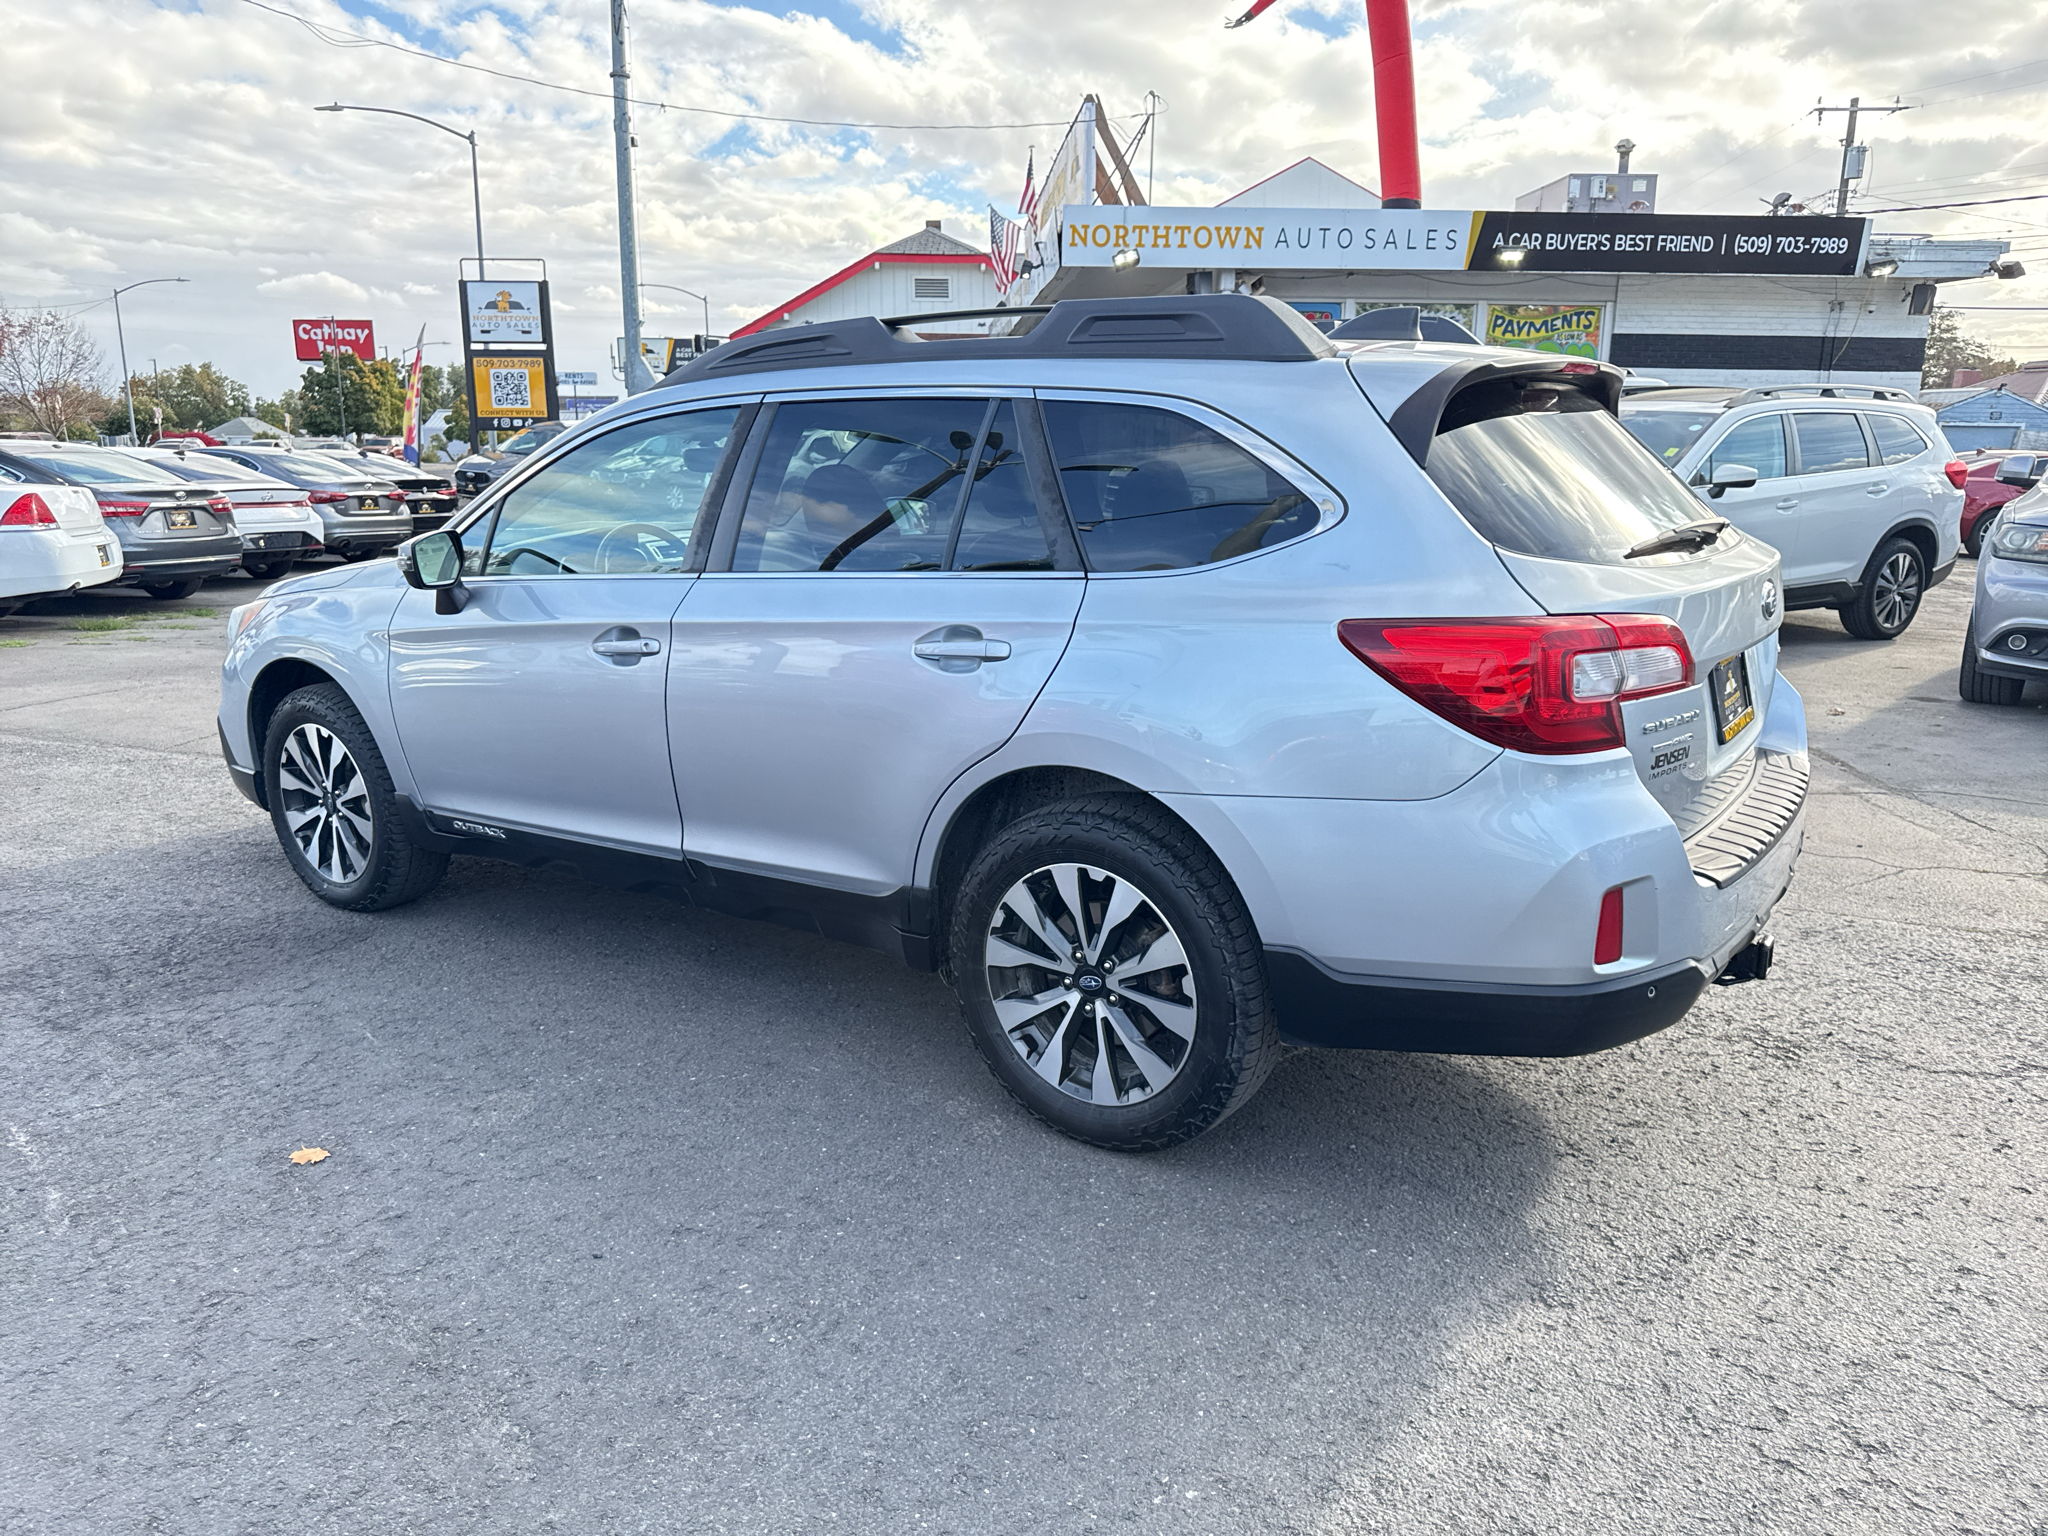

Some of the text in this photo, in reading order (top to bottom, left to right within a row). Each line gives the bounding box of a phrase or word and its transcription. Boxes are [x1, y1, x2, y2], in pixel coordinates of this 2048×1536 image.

[1069, 224, 1458, 250] NORTHTOWN AUTO SALES
[1492, 232, 1849, 255] A CAR BUYER'S BEST FRIEND (509) 703-7989
[471, 321, 500, 329] AUTO
[472, 314, 540, 322] NORTHTOWN
[1491, 310, 1596, 337] PAYMENTS
[298, 323, 370, 344] Cathay
[476, 359, 542, 368] 509-703-7989
[1642, 709, 1700, 734] SUBARU
[1651, 745, 1691, 770] JENSEN
[1648, 761, 1688, 781] IMPORTS
[453, 820, 506, 839] OUTBACK
